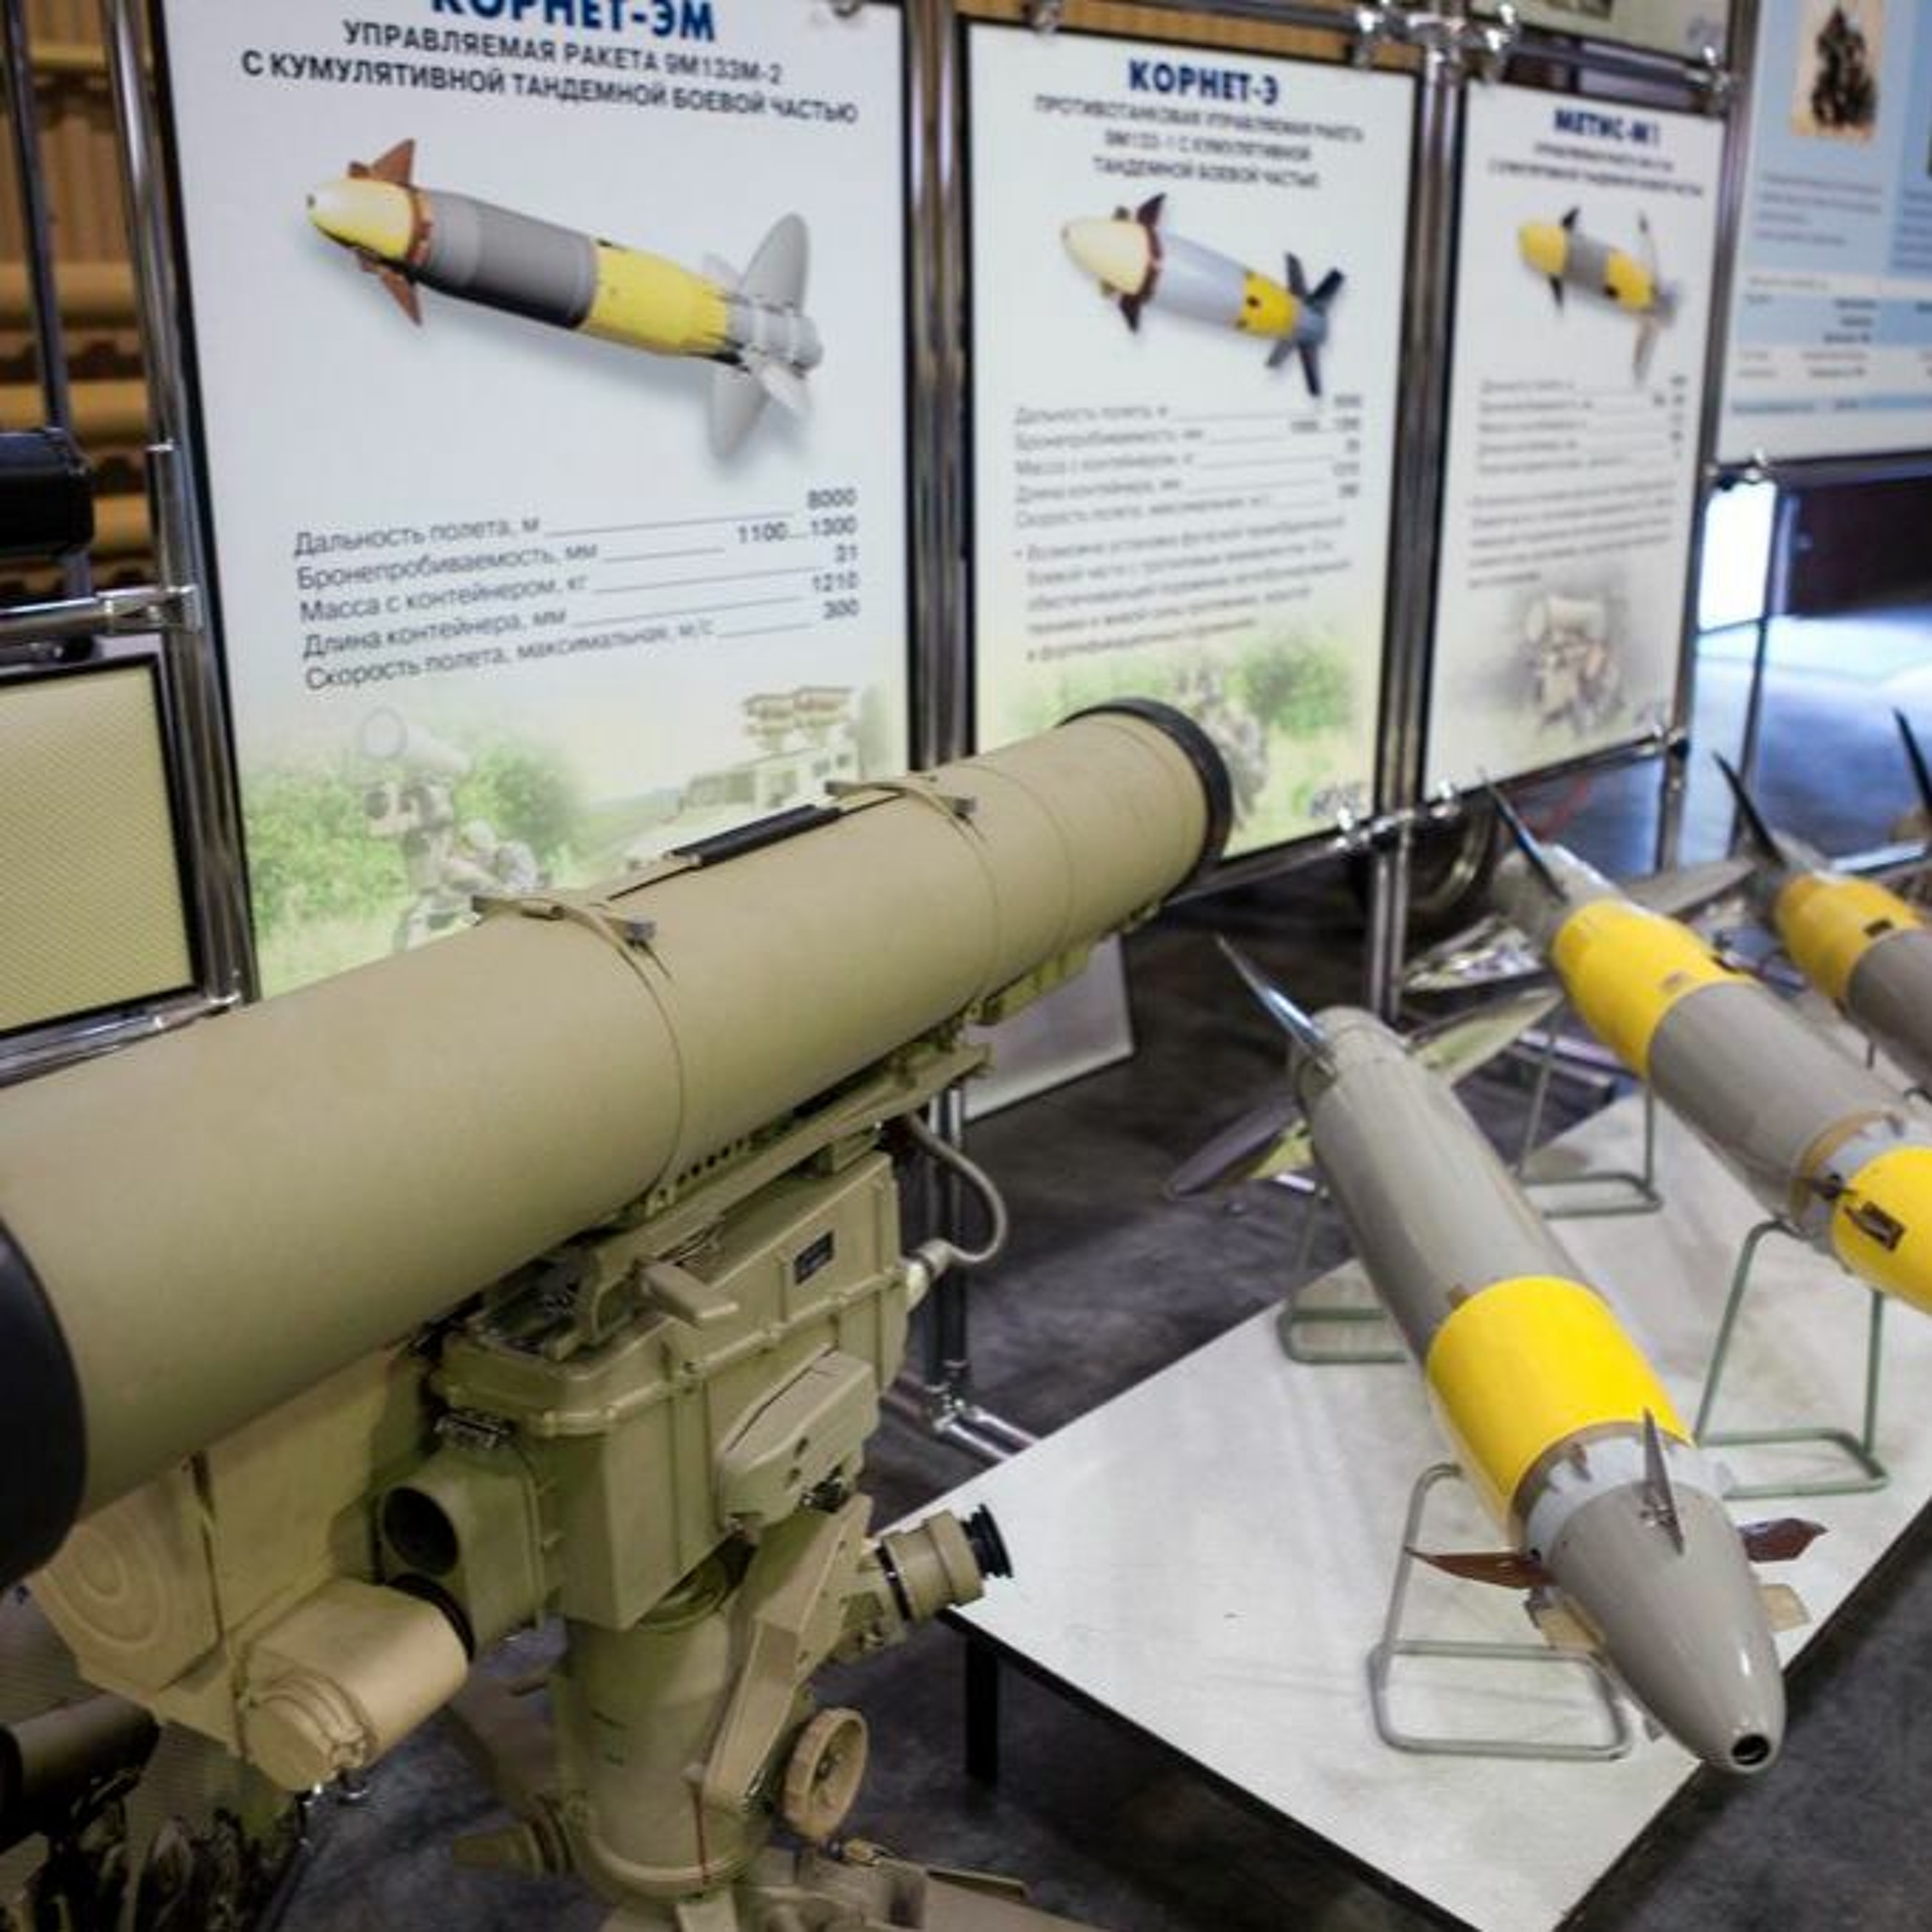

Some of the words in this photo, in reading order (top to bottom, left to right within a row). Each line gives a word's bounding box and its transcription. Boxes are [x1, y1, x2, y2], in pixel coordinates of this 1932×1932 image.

[342, 20, 555, 62] УПРАВЛЯЕМАЯ
[564, 43, 658, 71] РАКЕТА
[242, 50, 263, 75] С
[270, 53, 504, 95] КУМУЛЯТИВНОЙ
[515, 73, 666, 106] ТАНДЕМНОЙ
[673, 87, 765, 113] БОЕВОЙ
[771, 99, 858, 124] ЧАСТЬЮ
[1129, 60, 1279, 105] КОРНЕТ-Э
[294, 529, 425, 558] Дальность
[807, 488, 858, 509] 8000
[565, 544, 597, 559] мм
[299, 597, 380, 621] Масса
[388, 596, 401, 613] с
[303, 632, 381, 660] Длина
[533, 610, 565, 626] мм
[306, 661, 420, 690] Скорость
